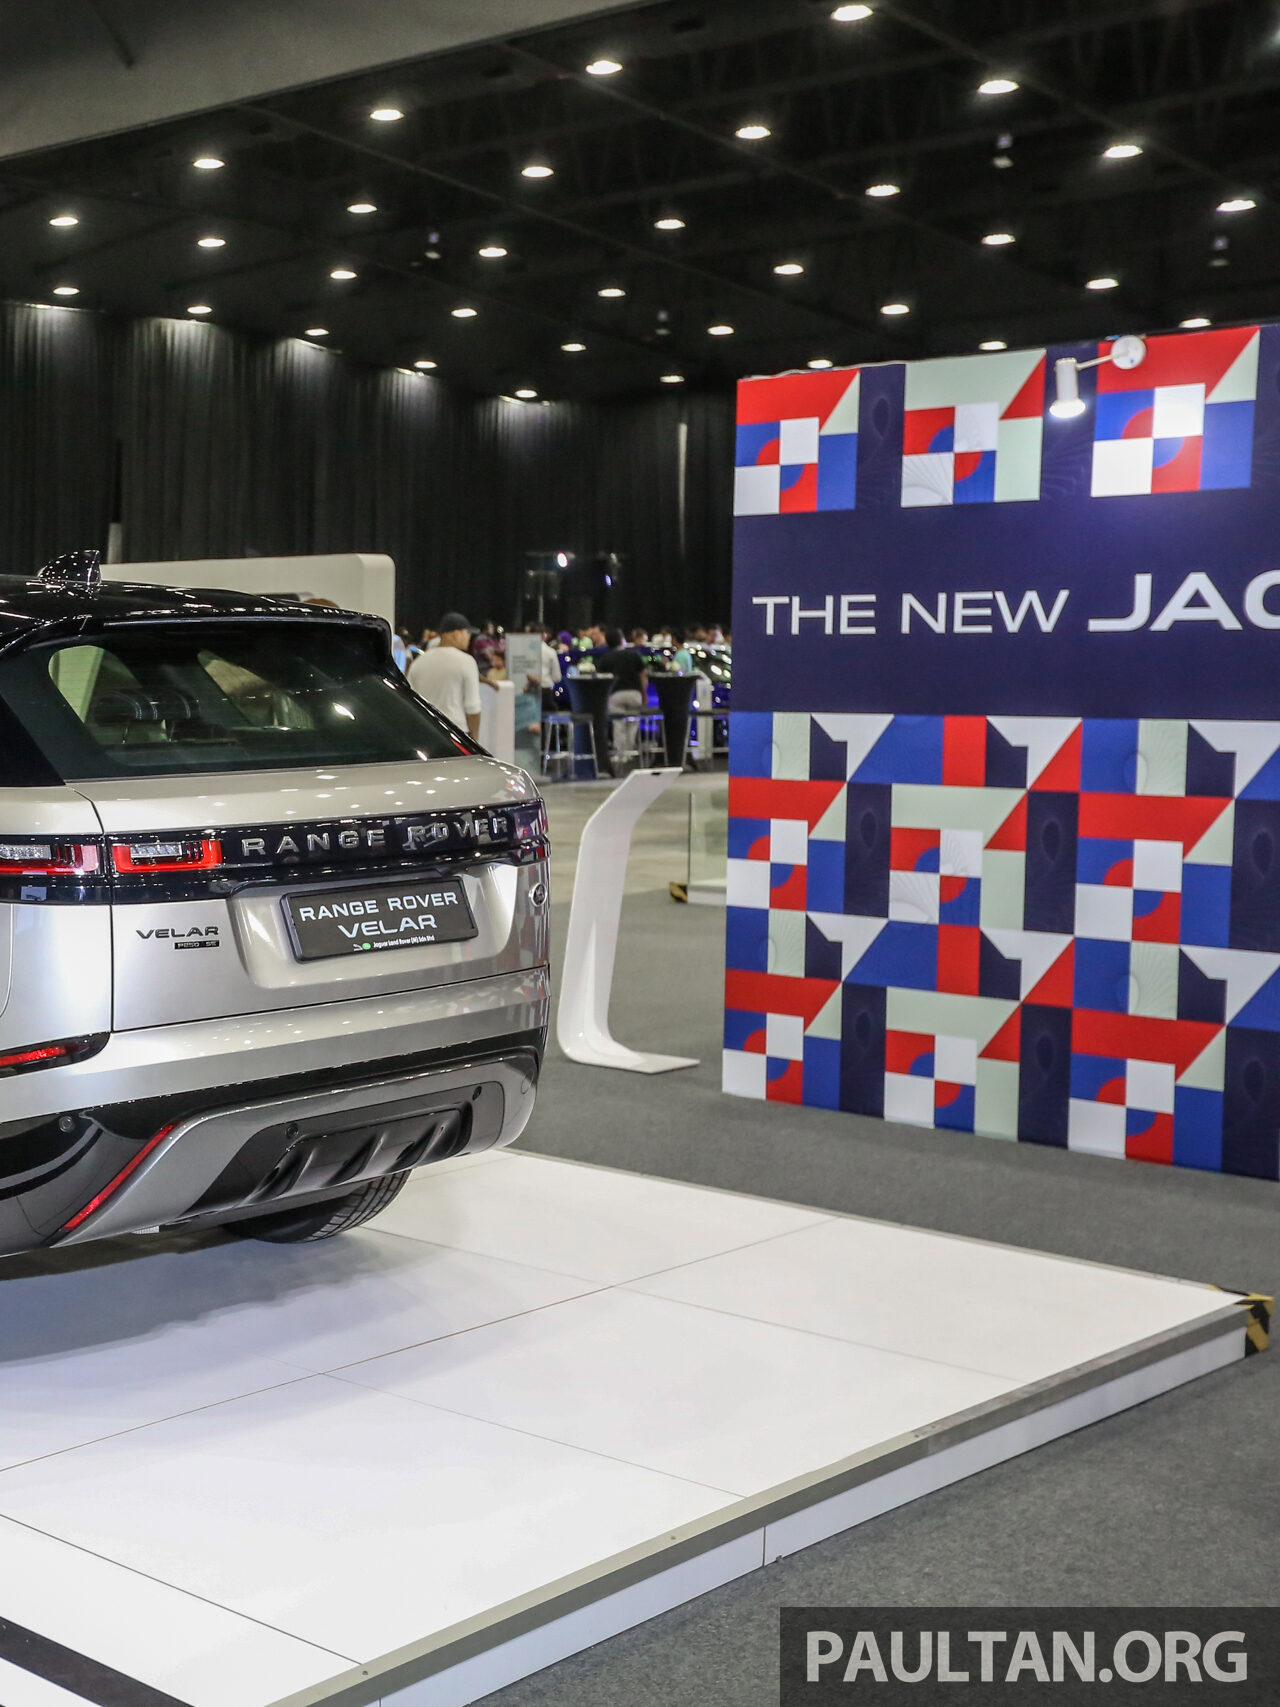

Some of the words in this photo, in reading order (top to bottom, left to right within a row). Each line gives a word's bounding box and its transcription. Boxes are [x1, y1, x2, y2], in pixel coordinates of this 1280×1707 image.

[752, 593, 877, 635] THE
[900, 588, 1070, 634] NEW
[241, 828, 386, 857] RANGE
[406, 815, 508, 844] ROVER
[299, 899, 380, 922] RANGE
[387, 891, 459, 912] ROVER
[135, 926, 219, 940] VELAR
[337, 914, 438, 939] VELAR
